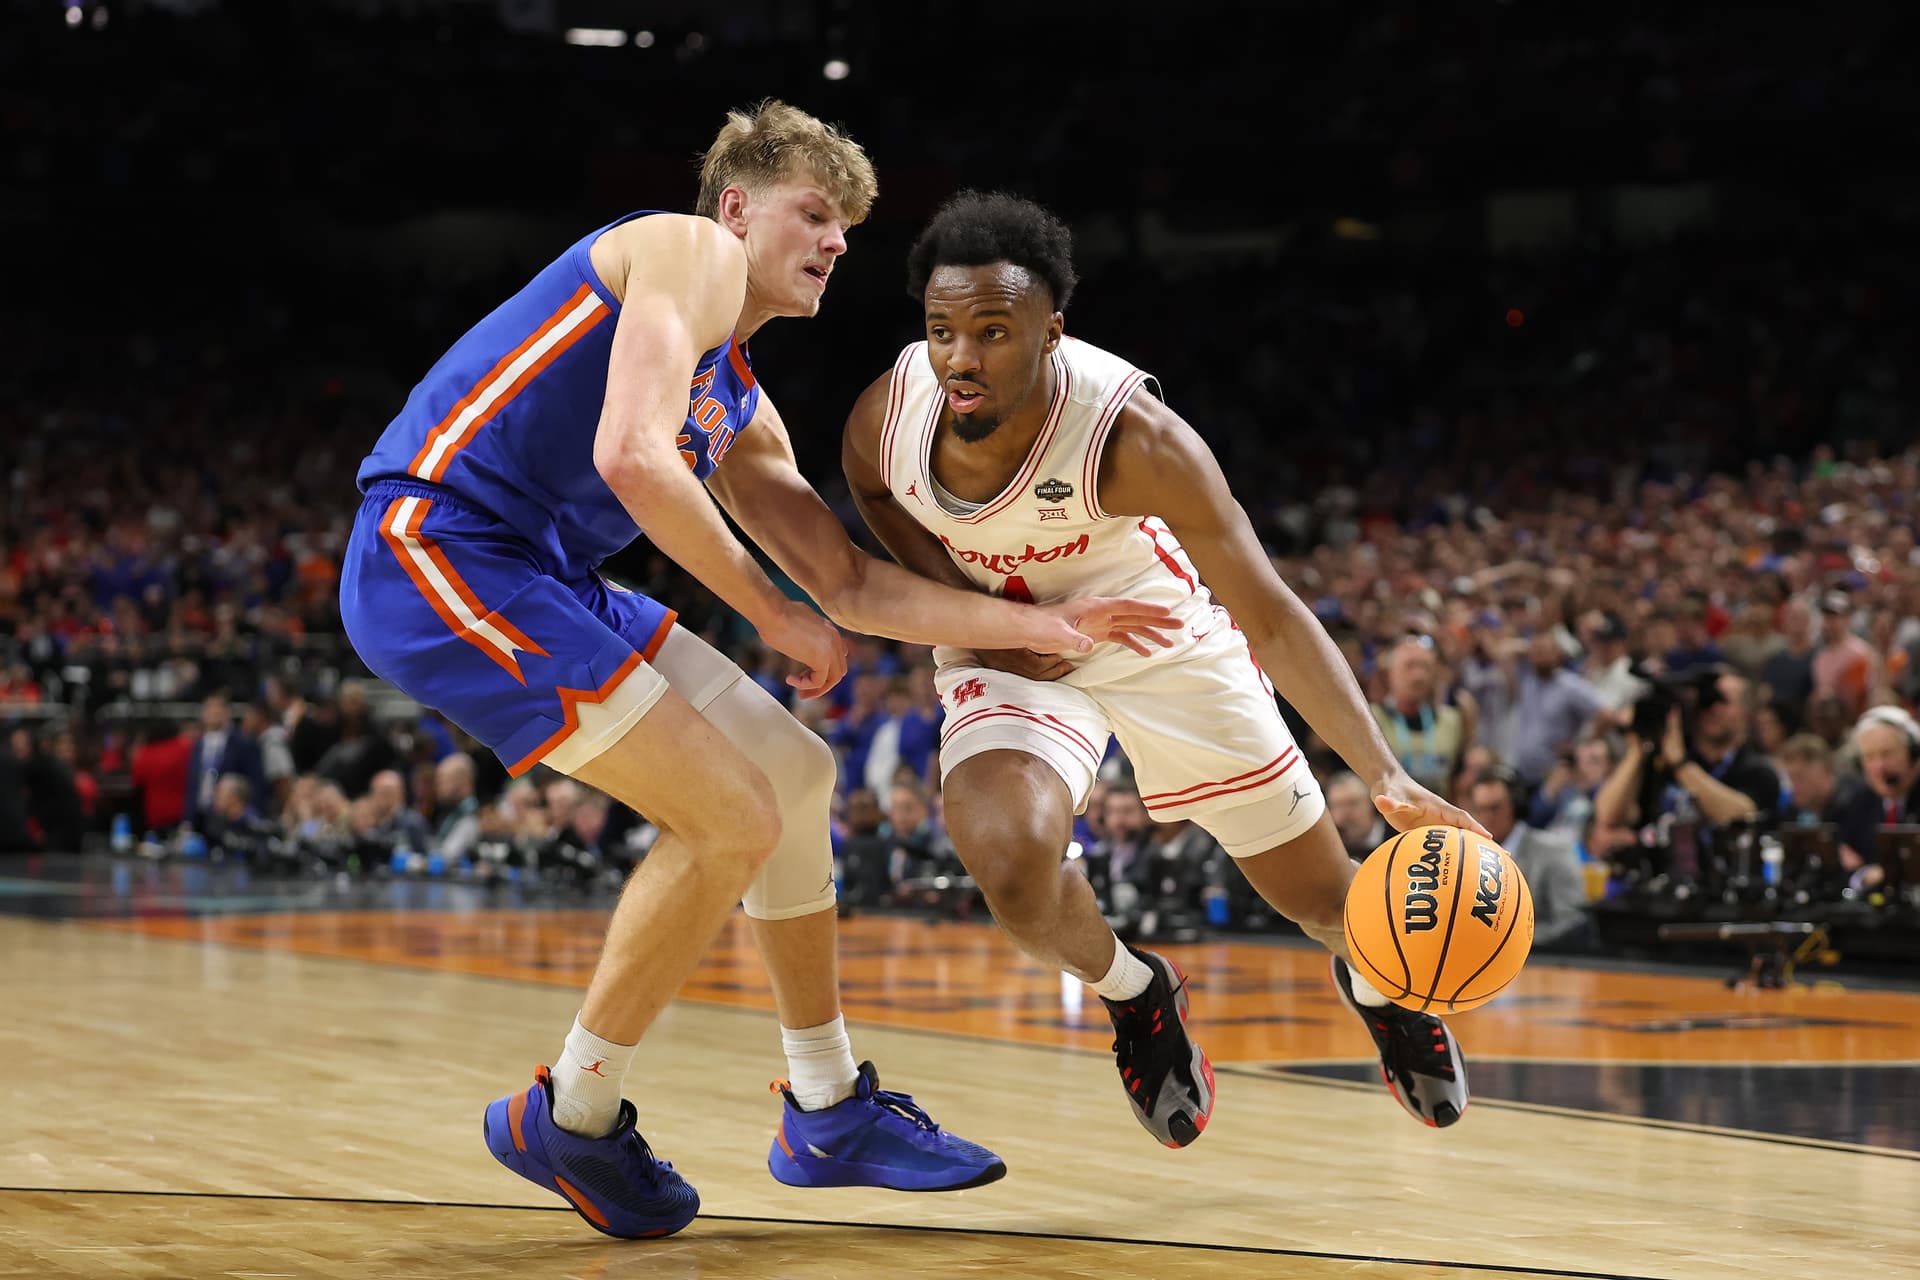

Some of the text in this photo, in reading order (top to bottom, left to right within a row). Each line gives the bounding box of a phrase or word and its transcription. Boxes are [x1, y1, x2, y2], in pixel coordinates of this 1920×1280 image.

[1037, 486, 1071, 495] FINAL FOUR
[1405, 829, 1449, 935] Wilson
[1444, 852, 1452, 868] NXT
[1470, 844, 1503, 929] NCAA
